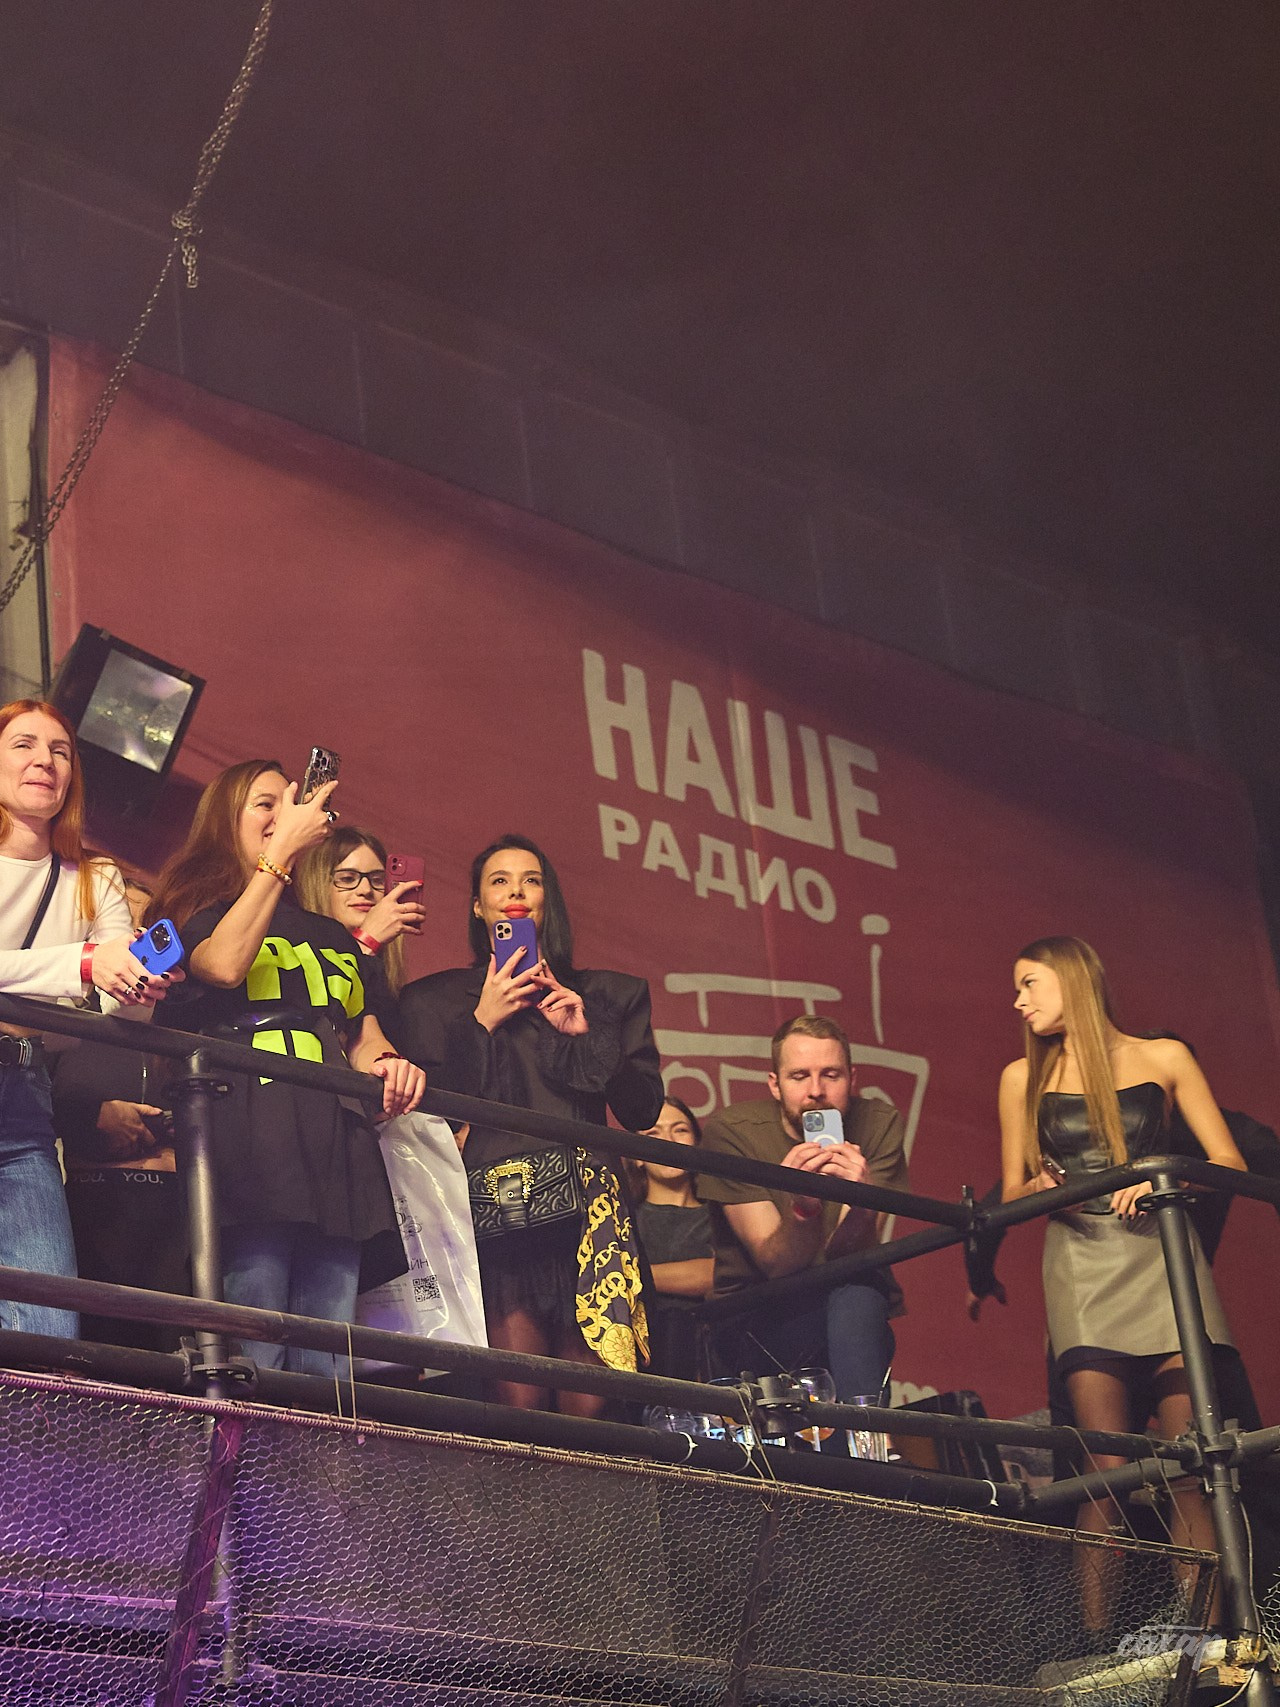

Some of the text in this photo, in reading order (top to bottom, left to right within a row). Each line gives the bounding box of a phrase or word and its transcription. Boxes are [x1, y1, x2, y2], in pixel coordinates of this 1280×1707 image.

[582, 648, 898, 869] НАШЕ
[598, 803, 837, 924] РАДИО
[122, 1172, 164, 1184] YOU.
